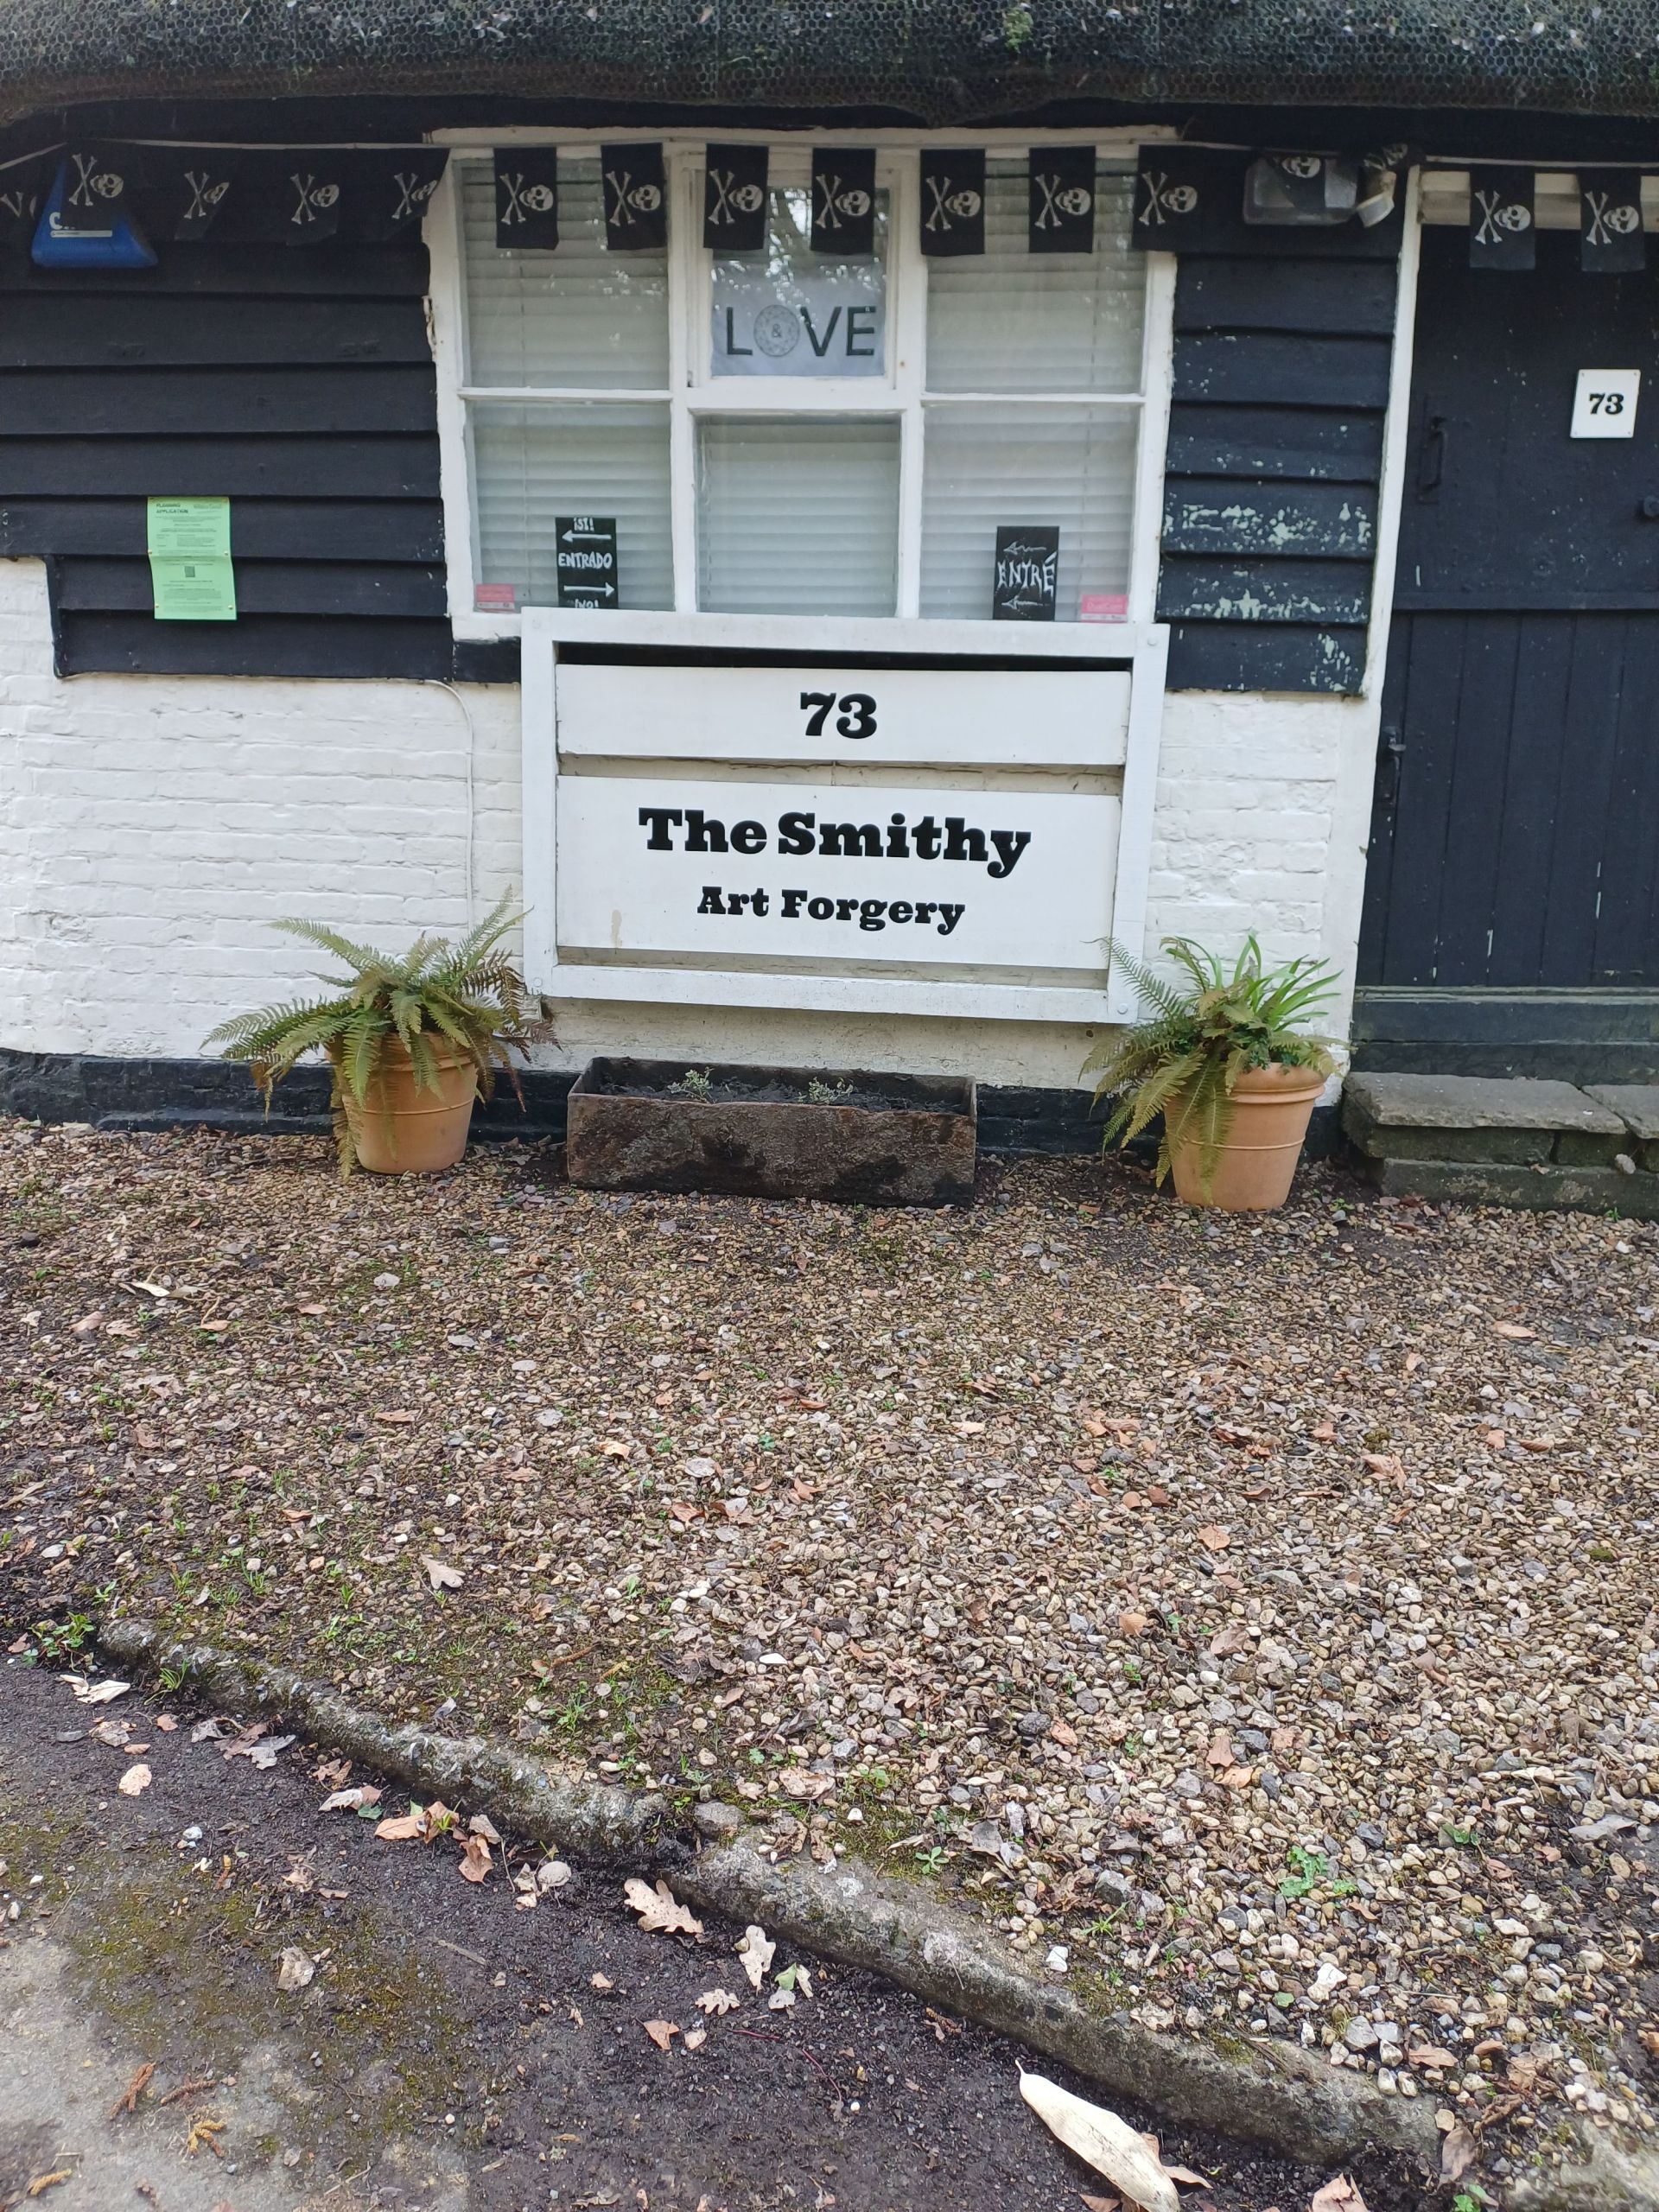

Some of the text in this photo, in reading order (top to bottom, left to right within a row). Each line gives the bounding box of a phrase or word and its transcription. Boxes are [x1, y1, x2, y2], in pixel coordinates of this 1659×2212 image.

[726, 304, 877, 358] LOVE
[1589, 391, 1624, 415] 73
[558, 550, 613, 569] ENTRADO
[996, 550, 1058, 598] ENTRÉ
[799, 691, 878, 740] 73
[638, 806, 1033, 879] The Smithy
[696, 885, 966, 936] Art Forgery
